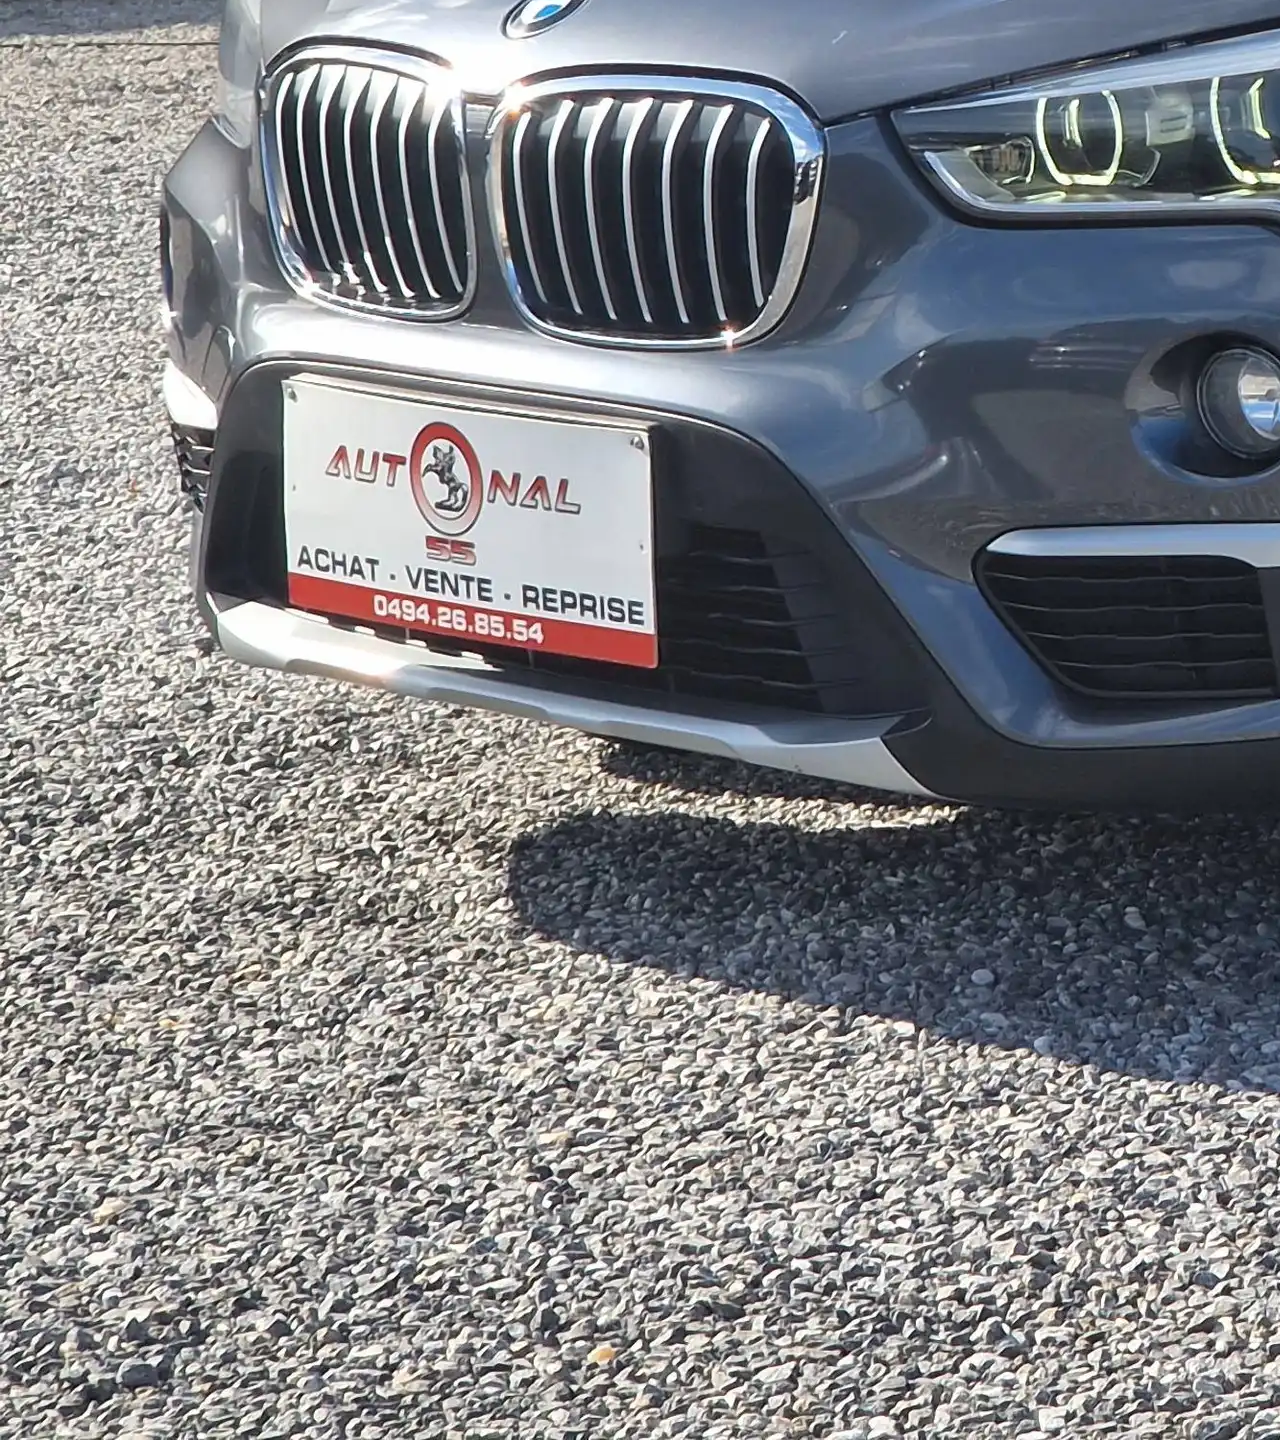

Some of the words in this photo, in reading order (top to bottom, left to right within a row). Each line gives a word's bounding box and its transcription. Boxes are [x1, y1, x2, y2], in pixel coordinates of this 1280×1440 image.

[325, 421, 581, 536] AUTONAL
[425, 536, 476, 566] 55
[297, 545, 380, 581] ACHAT
[405, 565, 494, 603] VENTE
[522, 585, 644, 626] REPRISE
[373, 595, 544, 644] 0494.26.85.54
